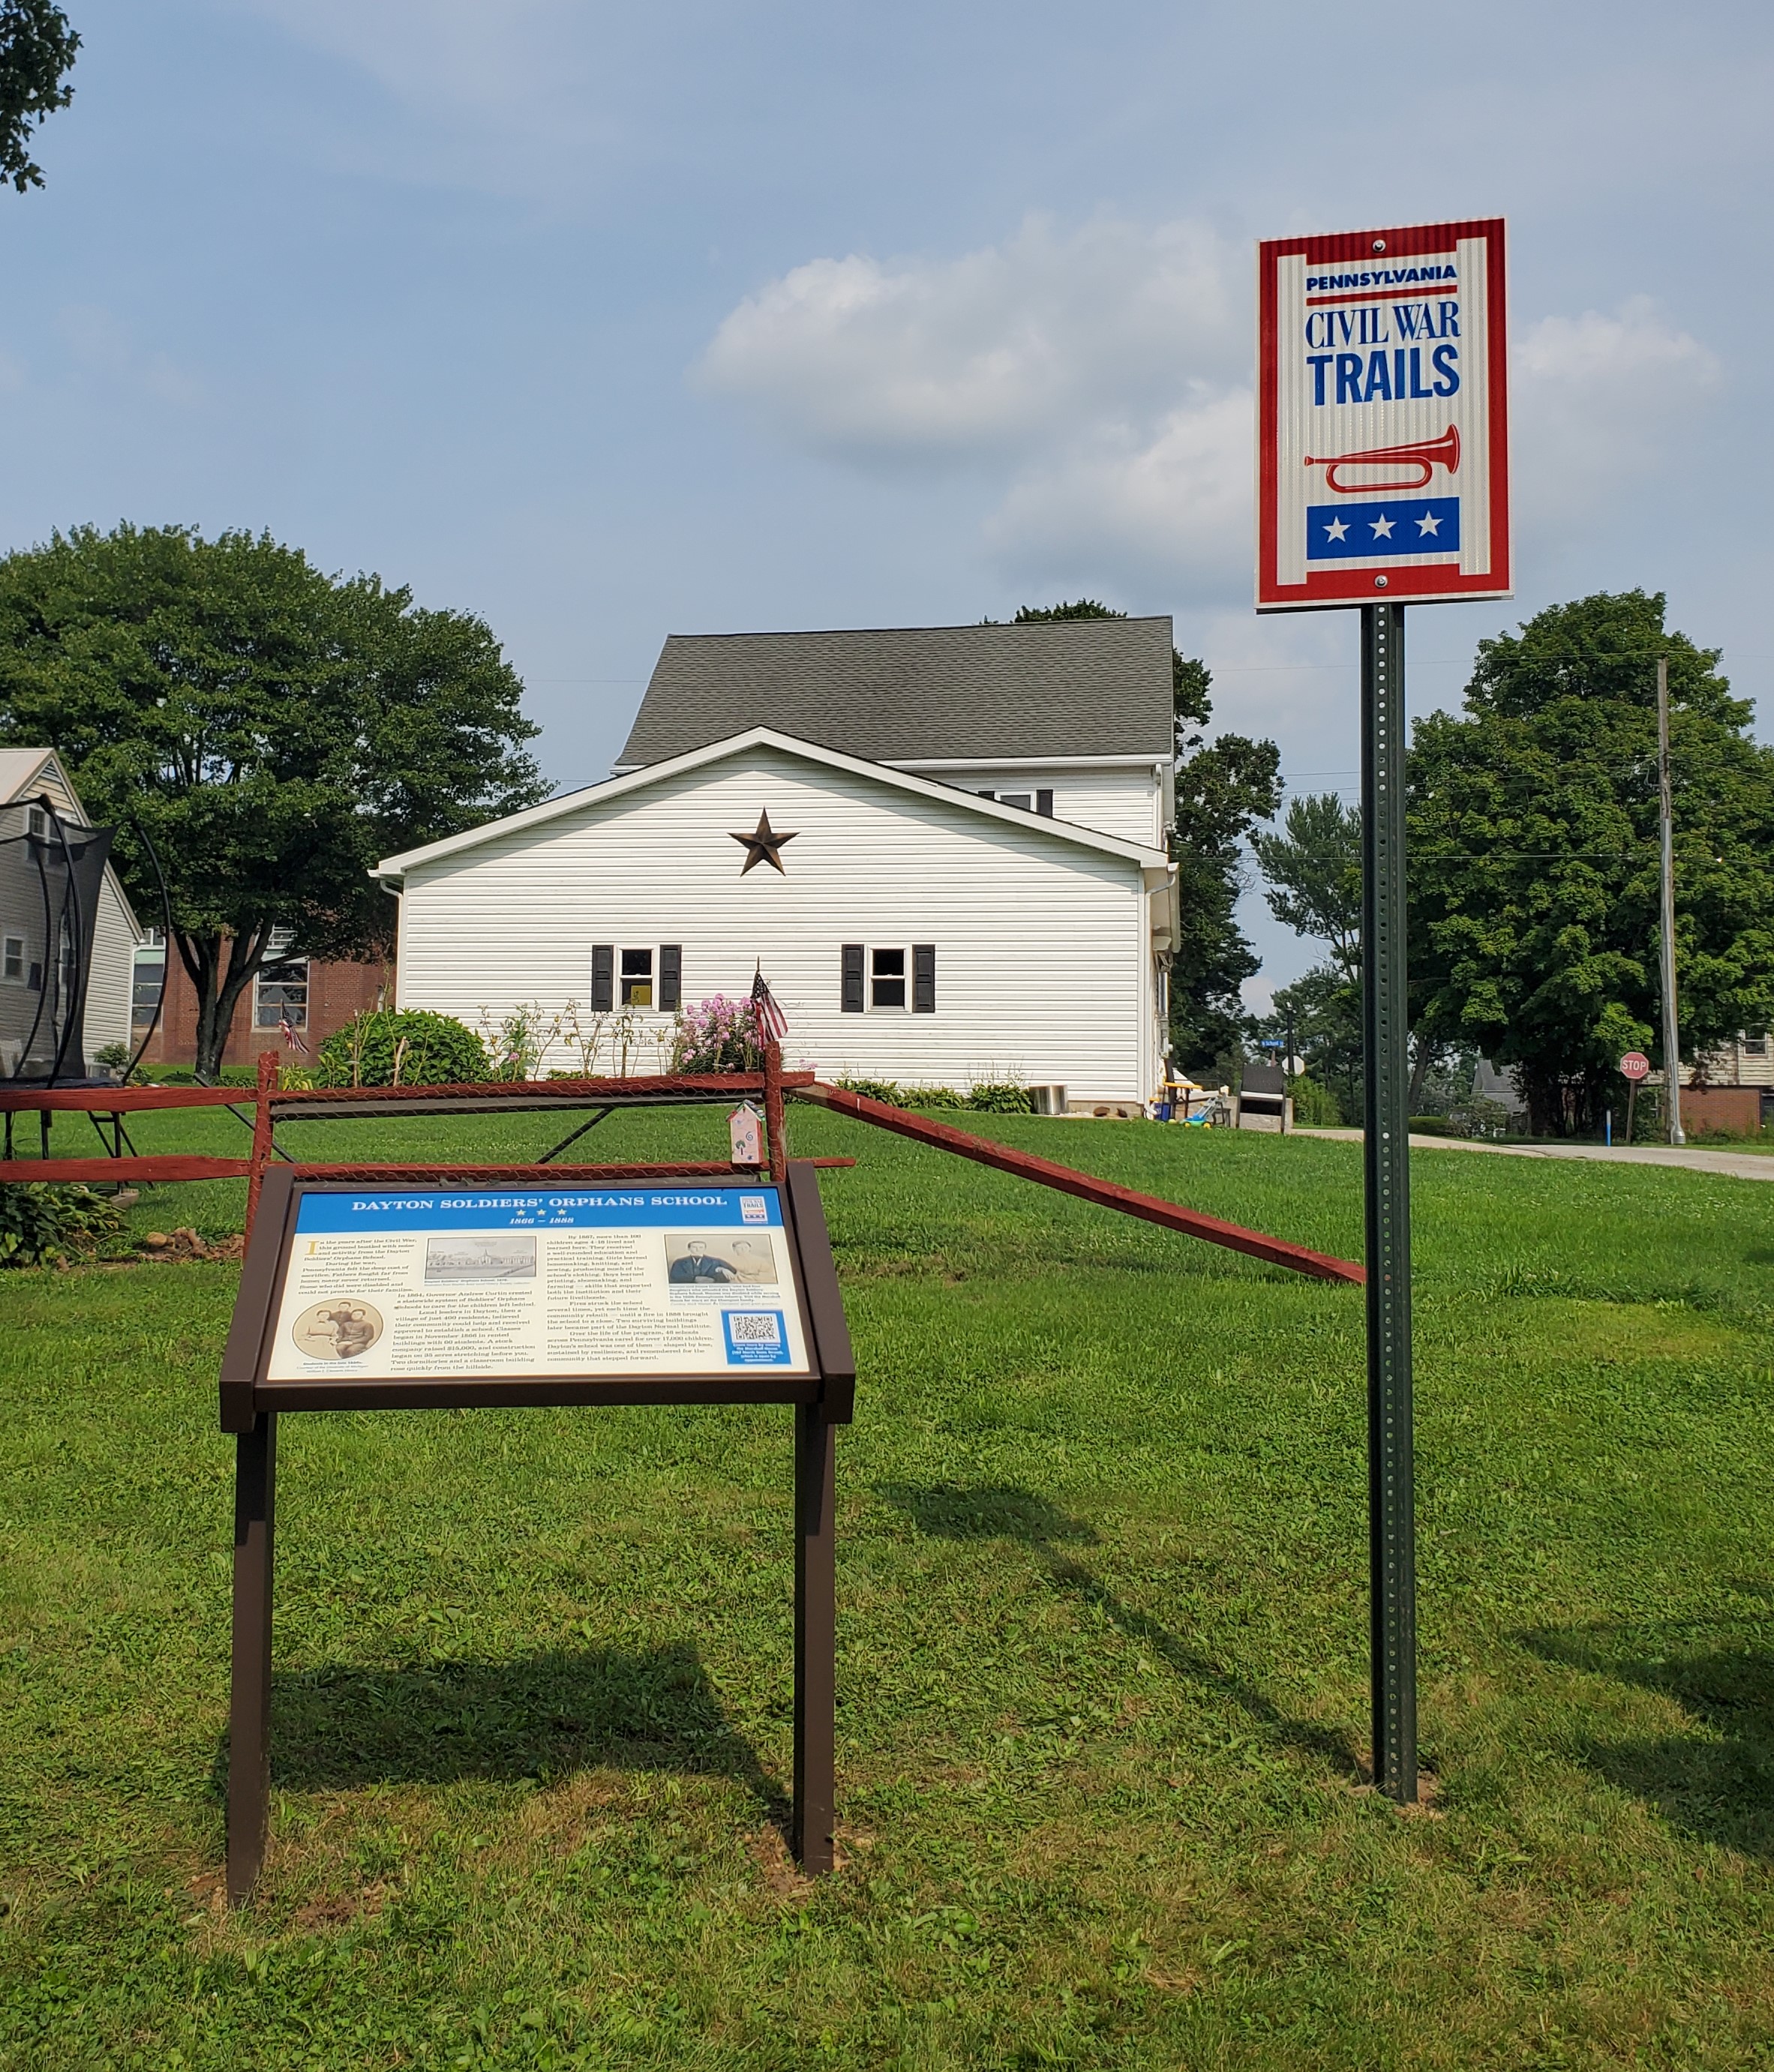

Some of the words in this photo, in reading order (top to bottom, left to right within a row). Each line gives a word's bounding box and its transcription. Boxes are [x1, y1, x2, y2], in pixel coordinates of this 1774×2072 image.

[1306, 265, 1457, 291] PENNSYLVANIA
[1305, 307, 1388, 349] CIVIL
[1392, 301, 1461, 341] WAR
[1306, 343, 1460, 406] TRAILS
[1622, 1060, 1646, 1072] STOP
[352, 1200, 434, 1210] DAYTON
[440, 1198, 543, 1209] SOLDIERS'
[548, 1197, 645, 1207] ORPHANS
[651, 1196, 728, 1206] SCHOOL
